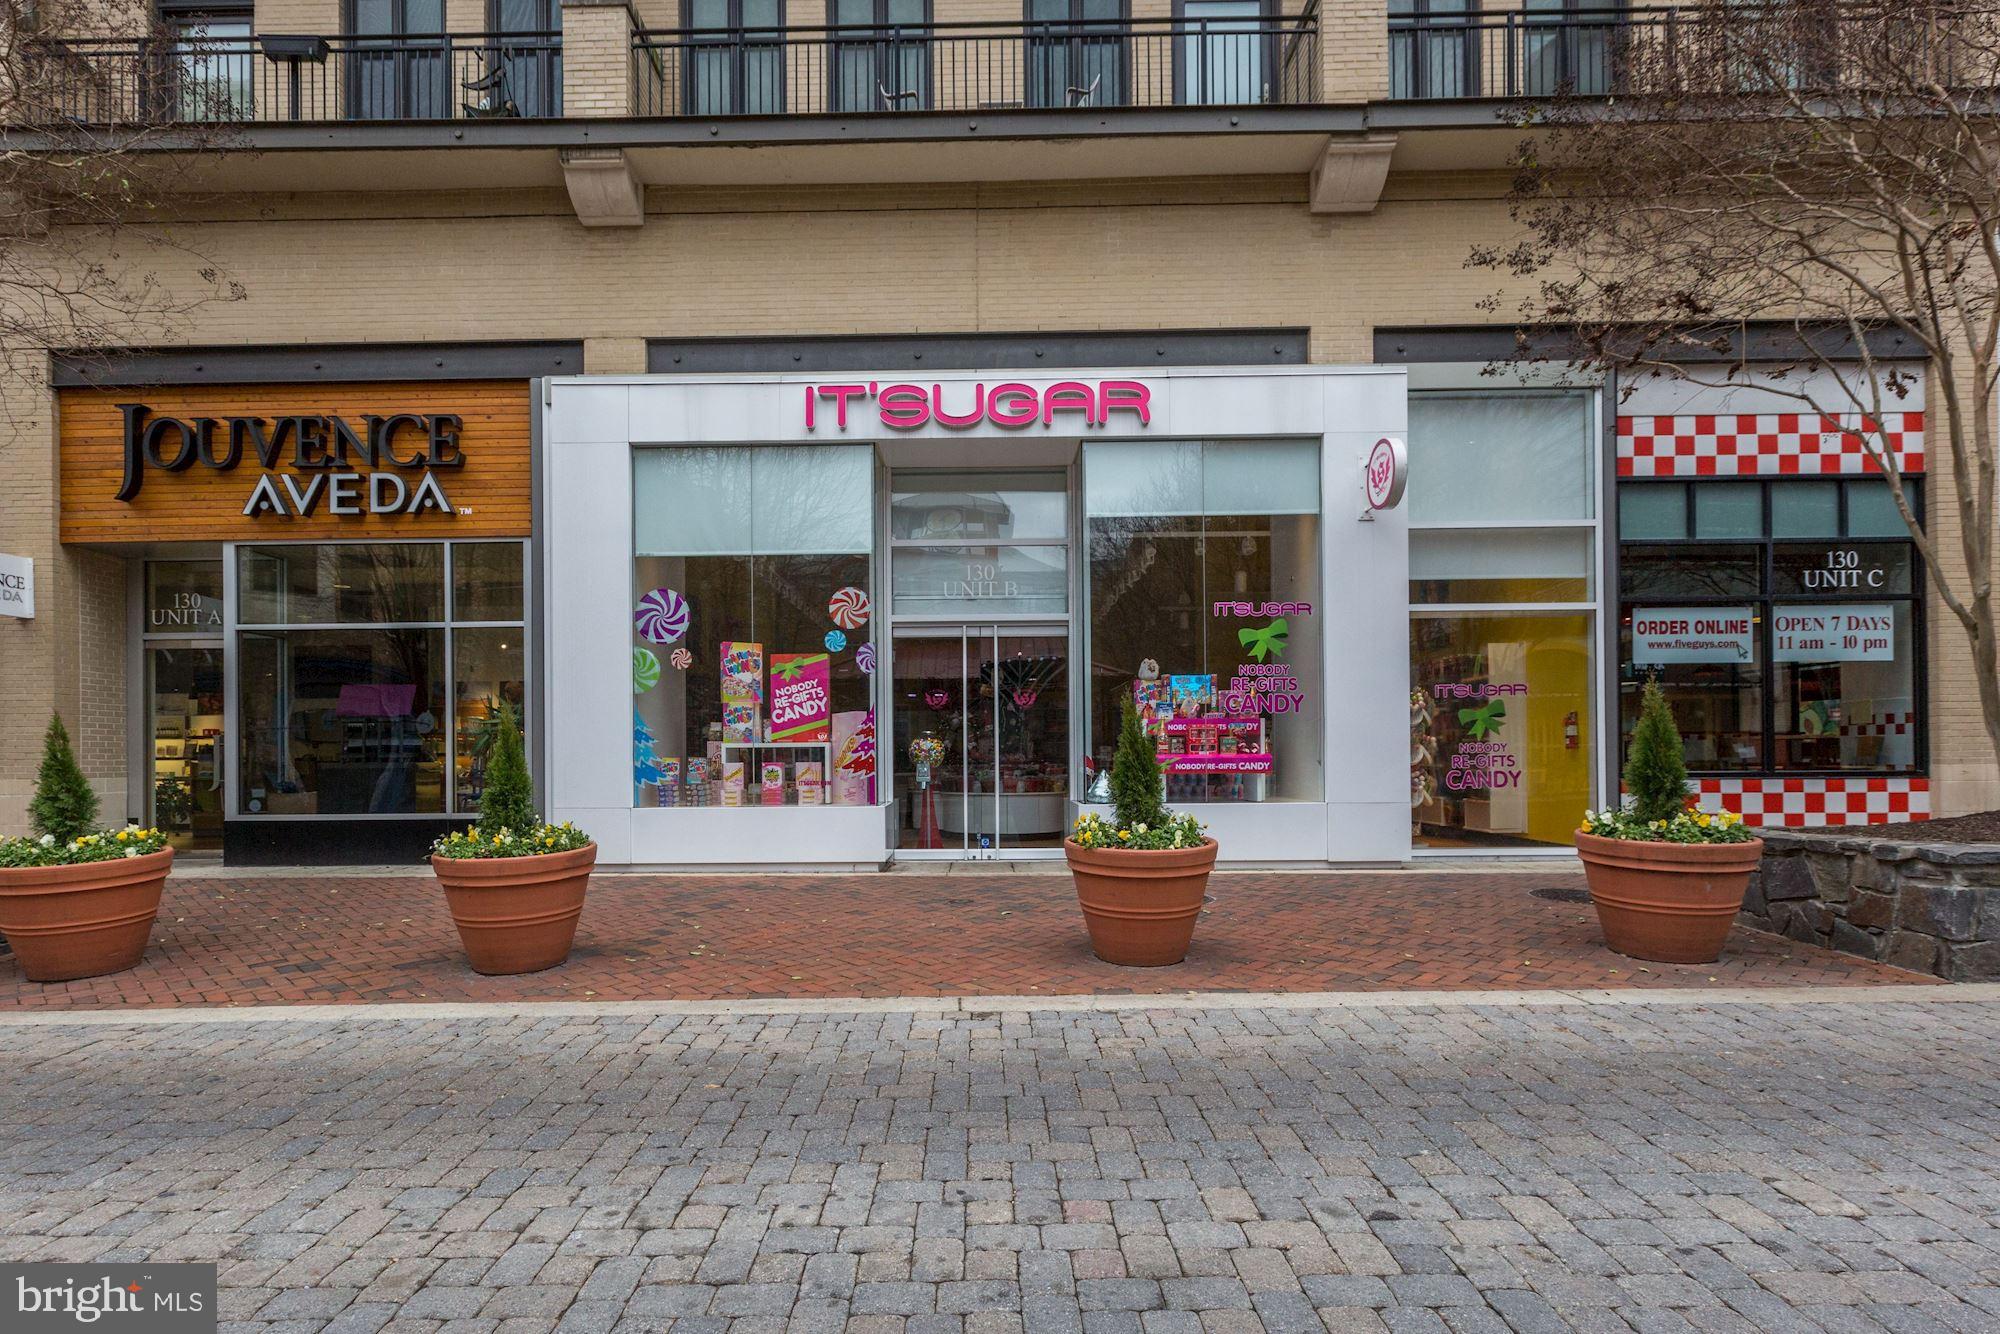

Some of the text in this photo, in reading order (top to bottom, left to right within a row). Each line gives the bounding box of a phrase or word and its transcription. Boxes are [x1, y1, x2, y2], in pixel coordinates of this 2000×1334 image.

[805, 381, 1151, 428] IT'SUGAR
[115, 403, 466, 501] JOUVENCE
[242, 470, 456, 516] AVEDA
[1827, 551, 1858, 568] 130
[966, 564, 995, 581] 130
[1803, 569, 1884, 588] UNIT C
[943, 581, 1018, 599] UNIT B
[174, 592, 202, 609] 130
[1214, 601, 1312, 617] IT'SUGAR
[151, 609, 222, 626] UNIT A
[1775, 615, 1891, 631] OPEN 7 DAYS
[1637, 620, 1749, 635] ORDER ONLINE
[1648, 640, 1738, 650] www.fiveguys.com
[1778, 636, 1793, 649] 11
[1799, 638, 1824, 649] am
[1842, 635, 1858, 649] 10
[1863, 638, 1888, 652] pm
[1238, 664, 1290, 676] NOBODY
[775, 679, 818, 697] NOBODY
[1231, 677, 1297, 691] RE-GIFTS
[1434, 683, 1528, 698] IT'SUGAR
[774, 687, 824, 708] RE-GIFTS
[1225, 693, 1304, 714] CANDY
[771, 697, 828, 723] CANDY
[1459, 743, 1507, 754] NOBODY
[1238, 762, 1270, 770] CANDY
[1451, 755, 1516, 769] RE-GIFTS
[1446, 769, 1522, 790] CANDY
